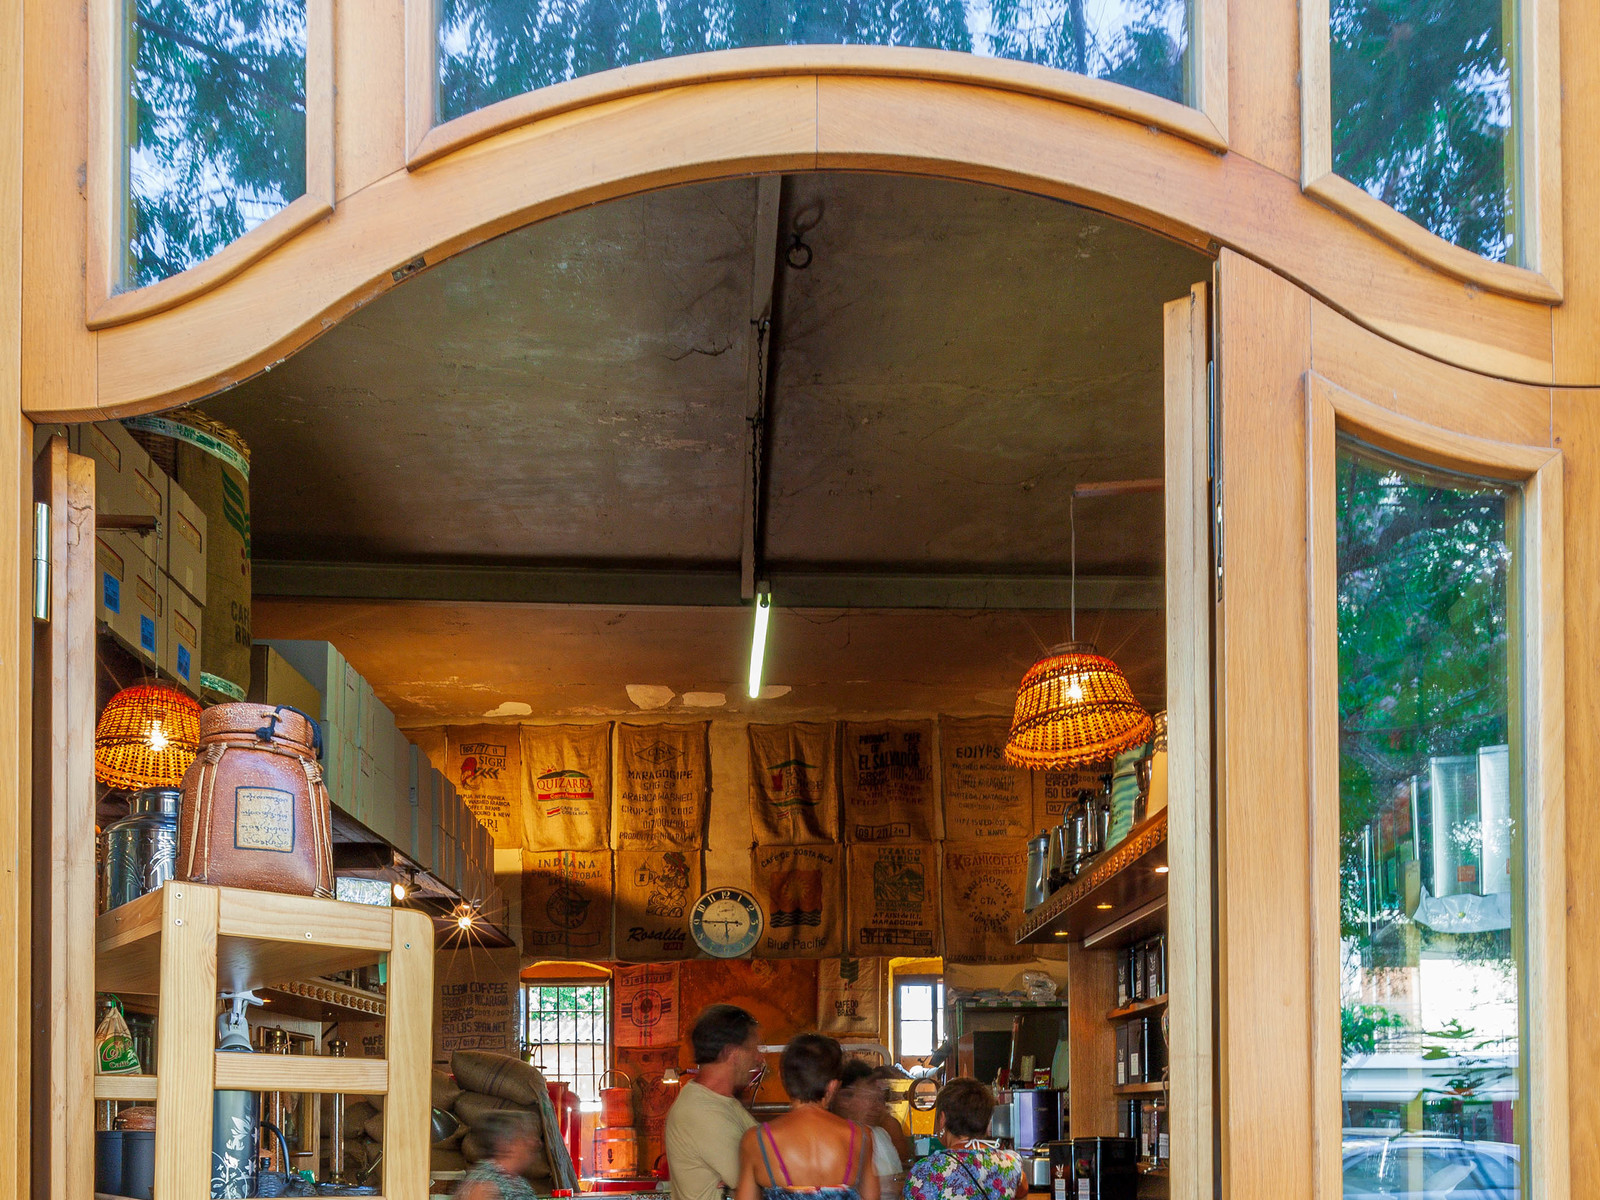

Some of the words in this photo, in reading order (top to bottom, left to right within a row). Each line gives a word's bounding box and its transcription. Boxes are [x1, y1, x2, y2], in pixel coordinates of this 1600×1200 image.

[956, 743, 1001, 759] EDIYPS
[479, 756, 506, 768] SIGRI
[859, 754, 871, 770] EL
[873, 750, 920, 770] SALVADOR
[628, 769, 693, 780] MARAGOGIPE
[537, 777, 593, 791] QUIZARRA
[622, 791, 656, 802] ARABICA
[722, 891, 730, 899] 12
[767, 937, 790, 950] Blue
[793, 935, 828, 950] Pacific
[470, 981, 508, 994] COFFEE
[837, 1008, 858, 1017] BRASIL
